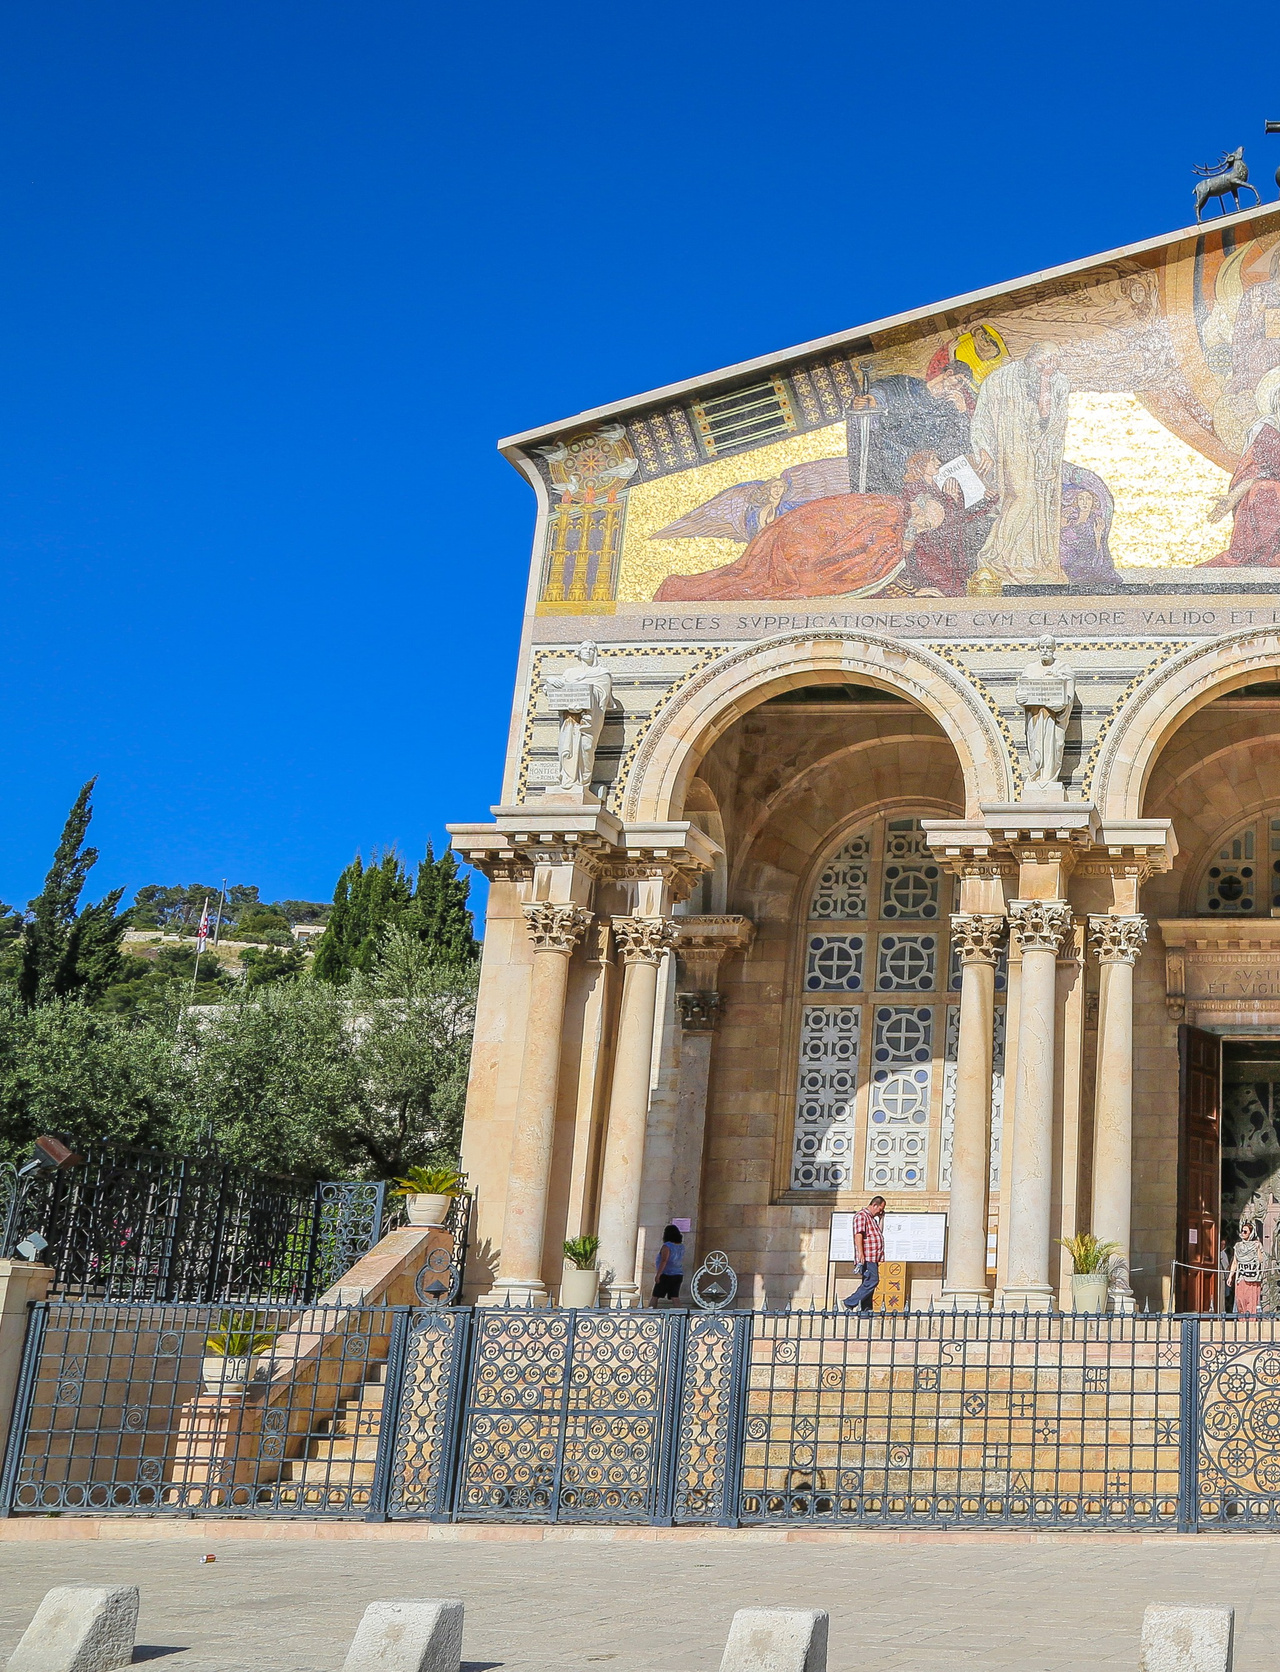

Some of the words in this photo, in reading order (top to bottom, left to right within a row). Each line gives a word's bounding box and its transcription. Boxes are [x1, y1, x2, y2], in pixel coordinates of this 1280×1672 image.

[641, 617, 721, 631] PRECES
[737, 613, 958, 630] SVPPLICATIONESQVE
[972, 613, 1014, 626] CVM
[1028, 612, 1125, 626] CLAMORE
[1142, 611, 1216, 625] VALIDO
[1231, 611, 1256, 624] ET
[1208, 983, 1230, 994] ET
